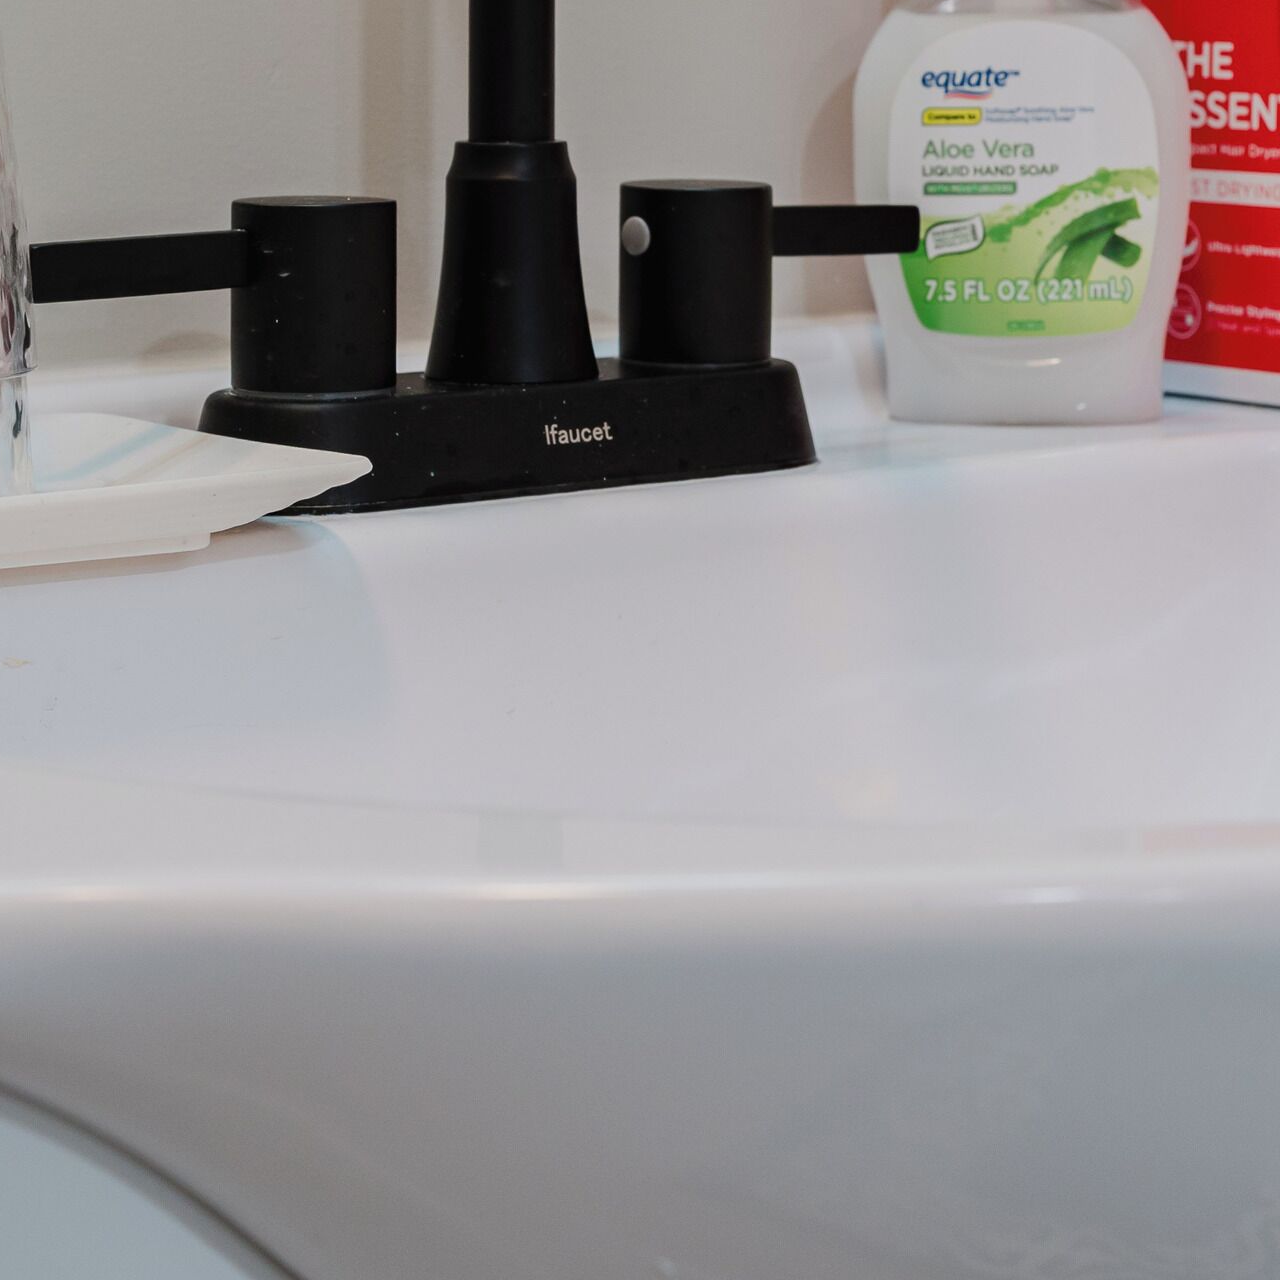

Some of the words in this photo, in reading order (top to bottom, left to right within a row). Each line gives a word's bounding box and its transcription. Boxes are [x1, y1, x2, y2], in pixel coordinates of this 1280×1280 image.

[923, 139, 975, 159] Aloe
[982, 139, 1035, 159] Vera
[922, 165, 970, 177] LIQUID
[974, 165, 1015, 176] HAND
[1020, 163, 1059, 176] SOAP
[1191, 178, 1209, 195] ST
[924, 279, 957, 302] 7.5
[964, 279, 991, 302] FL
[998, 279, 1031, 302] OZ
[1037, 278, 1083, 303] (221
[1089, 277, 1133, 303] mL)
